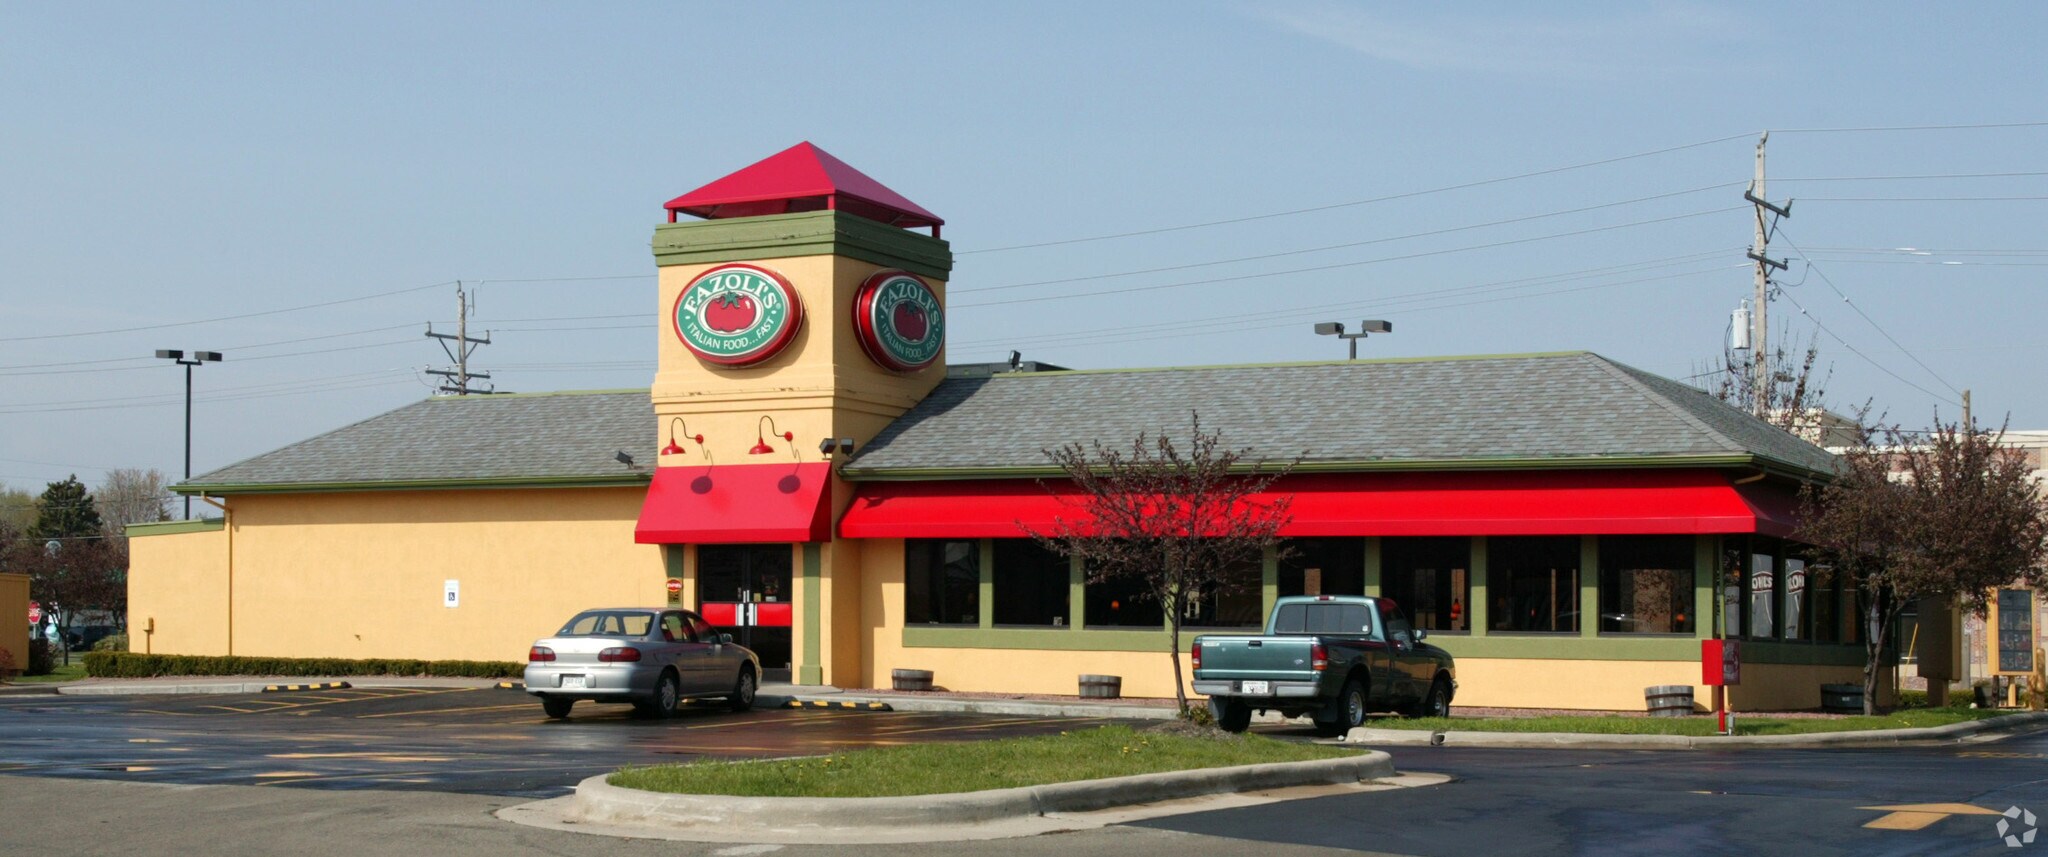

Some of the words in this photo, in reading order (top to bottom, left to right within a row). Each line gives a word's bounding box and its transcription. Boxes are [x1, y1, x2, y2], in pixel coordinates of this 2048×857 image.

[683, 274, 777, 315] FAZOLI'S
[880, 282, 939, 325] FAZOLI'S
[687, 322, 720, 349] ITALIAN
[882, 323, 904, 354] ITALIAN
